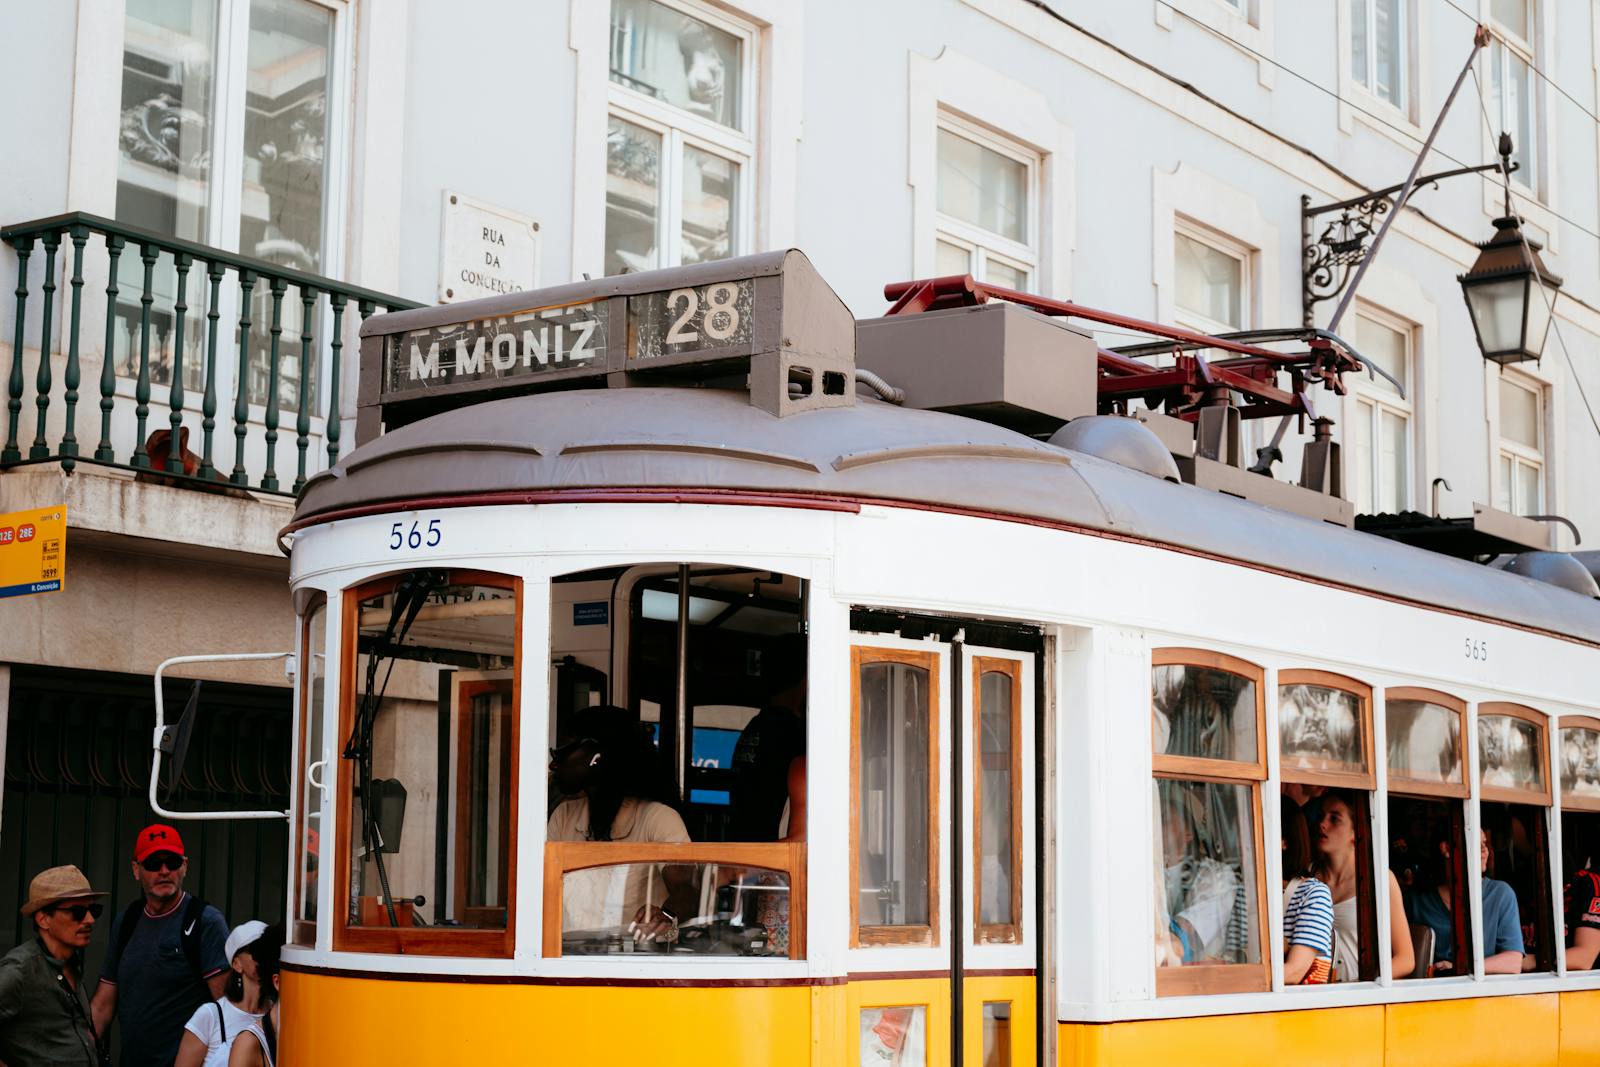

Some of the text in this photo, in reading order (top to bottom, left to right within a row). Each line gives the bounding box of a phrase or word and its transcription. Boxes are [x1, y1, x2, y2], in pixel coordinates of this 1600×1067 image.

[482, 227, 505, 247] RUA
[485, 252, 501, 269] DA
[665, 281, 740, 344] 28
[0, 527, 33, 542] 12E 28E
[389, 519, 442, 551] 565
[1465, 638, 1487, 661] 565
